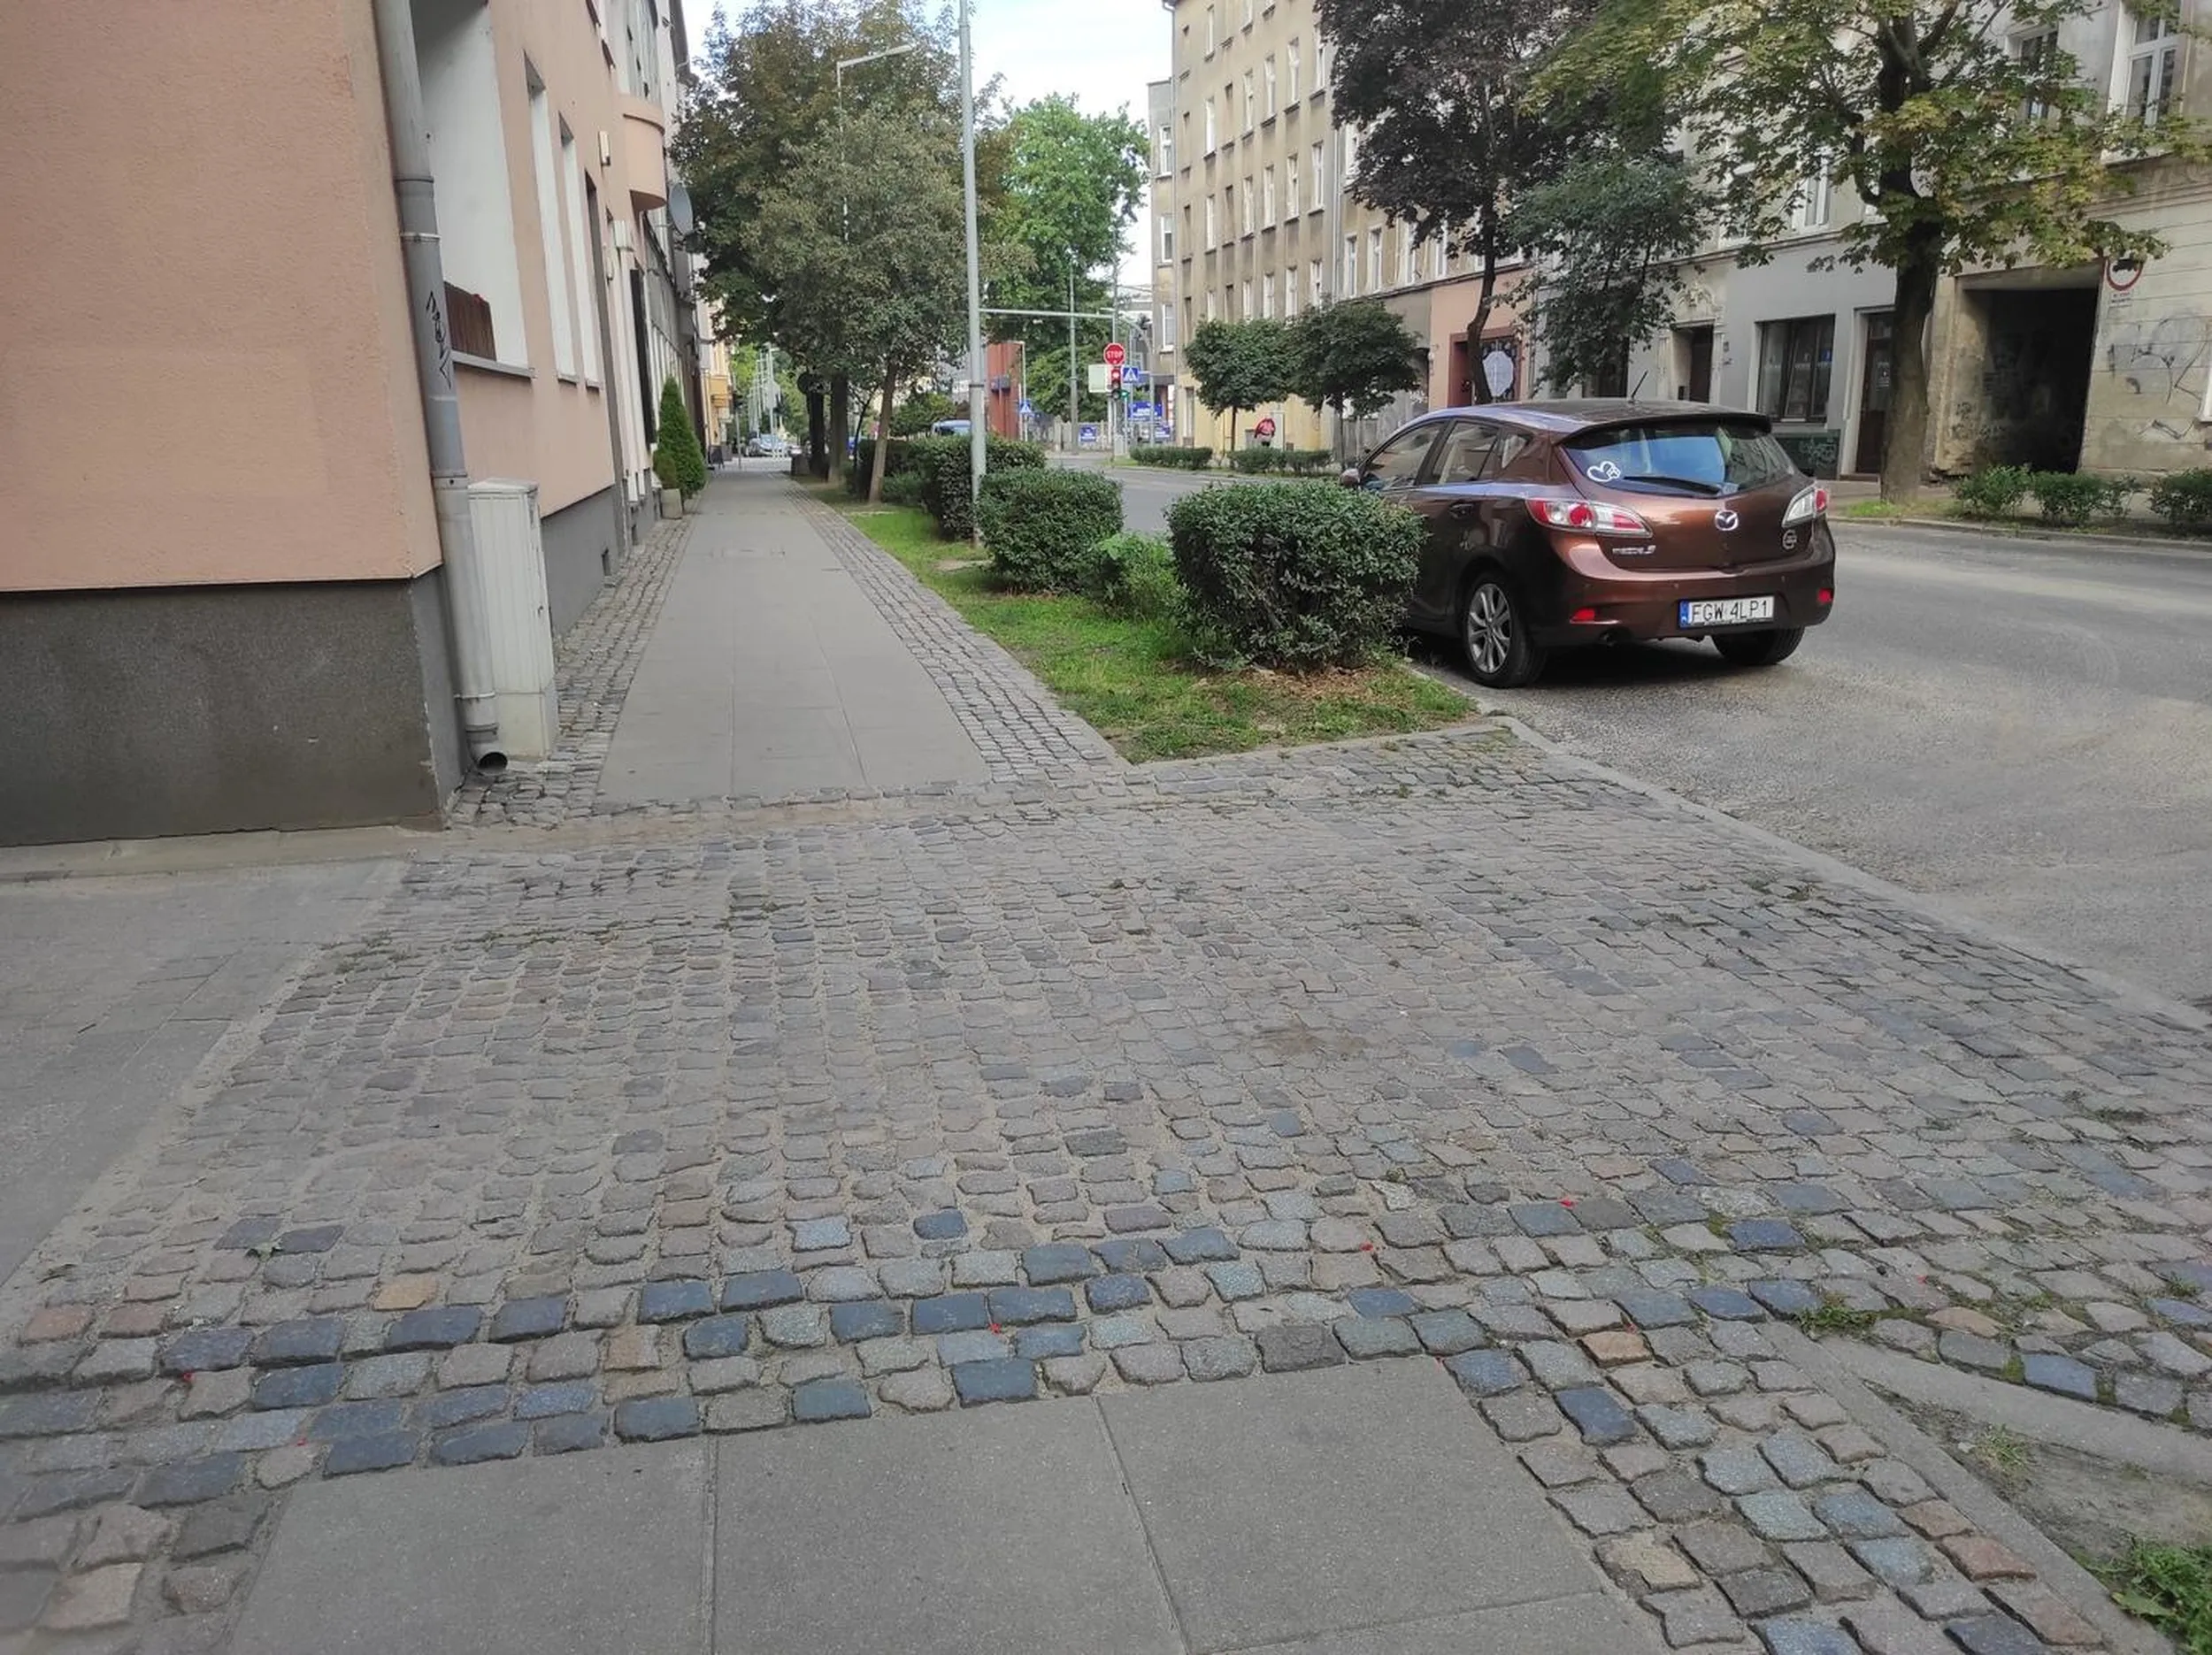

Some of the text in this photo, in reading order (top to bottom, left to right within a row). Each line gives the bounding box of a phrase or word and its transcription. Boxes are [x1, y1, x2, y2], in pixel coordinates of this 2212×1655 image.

[1106, 350, 1124, 359] STOP
[1692, 600, 1768, 622] FGW 4LP1
